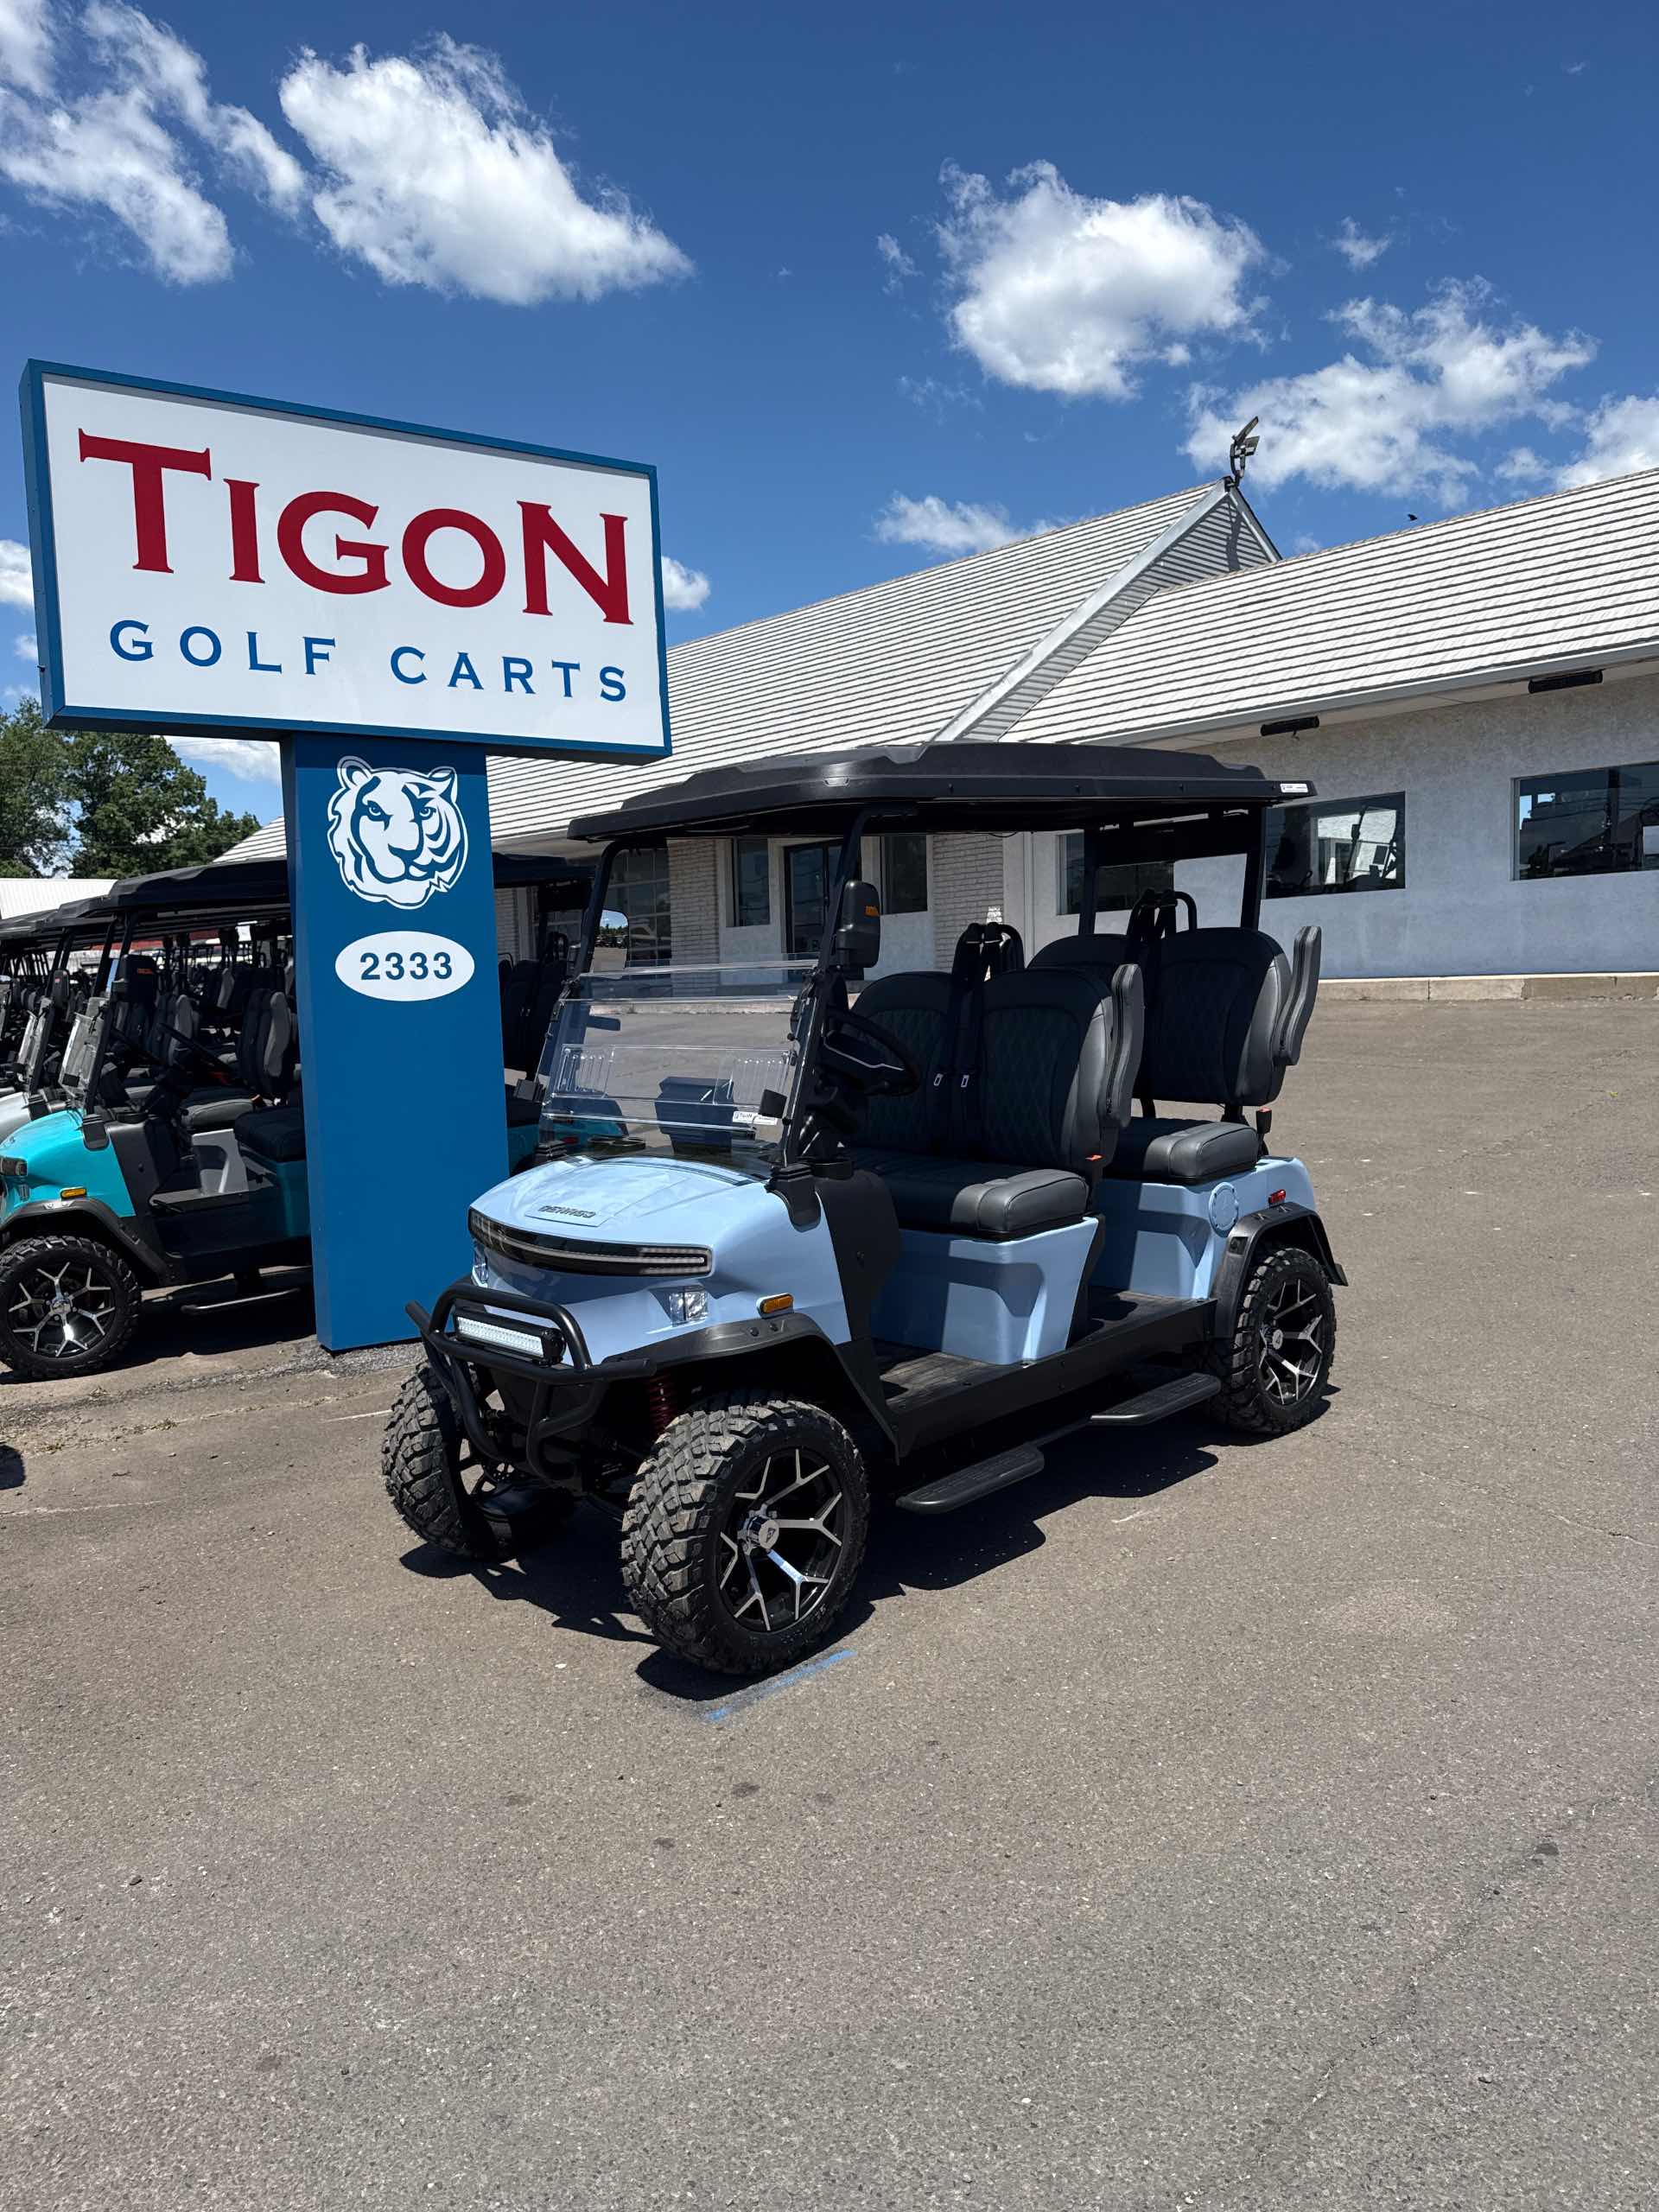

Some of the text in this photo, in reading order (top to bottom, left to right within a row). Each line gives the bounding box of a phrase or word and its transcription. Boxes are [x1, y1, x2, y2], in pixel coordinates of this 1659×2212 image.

[79, 429, 633, 625] TIGON
[111, 620, 627, 702] GOLF CARTS
[359, 951, 453, 981] 2333
